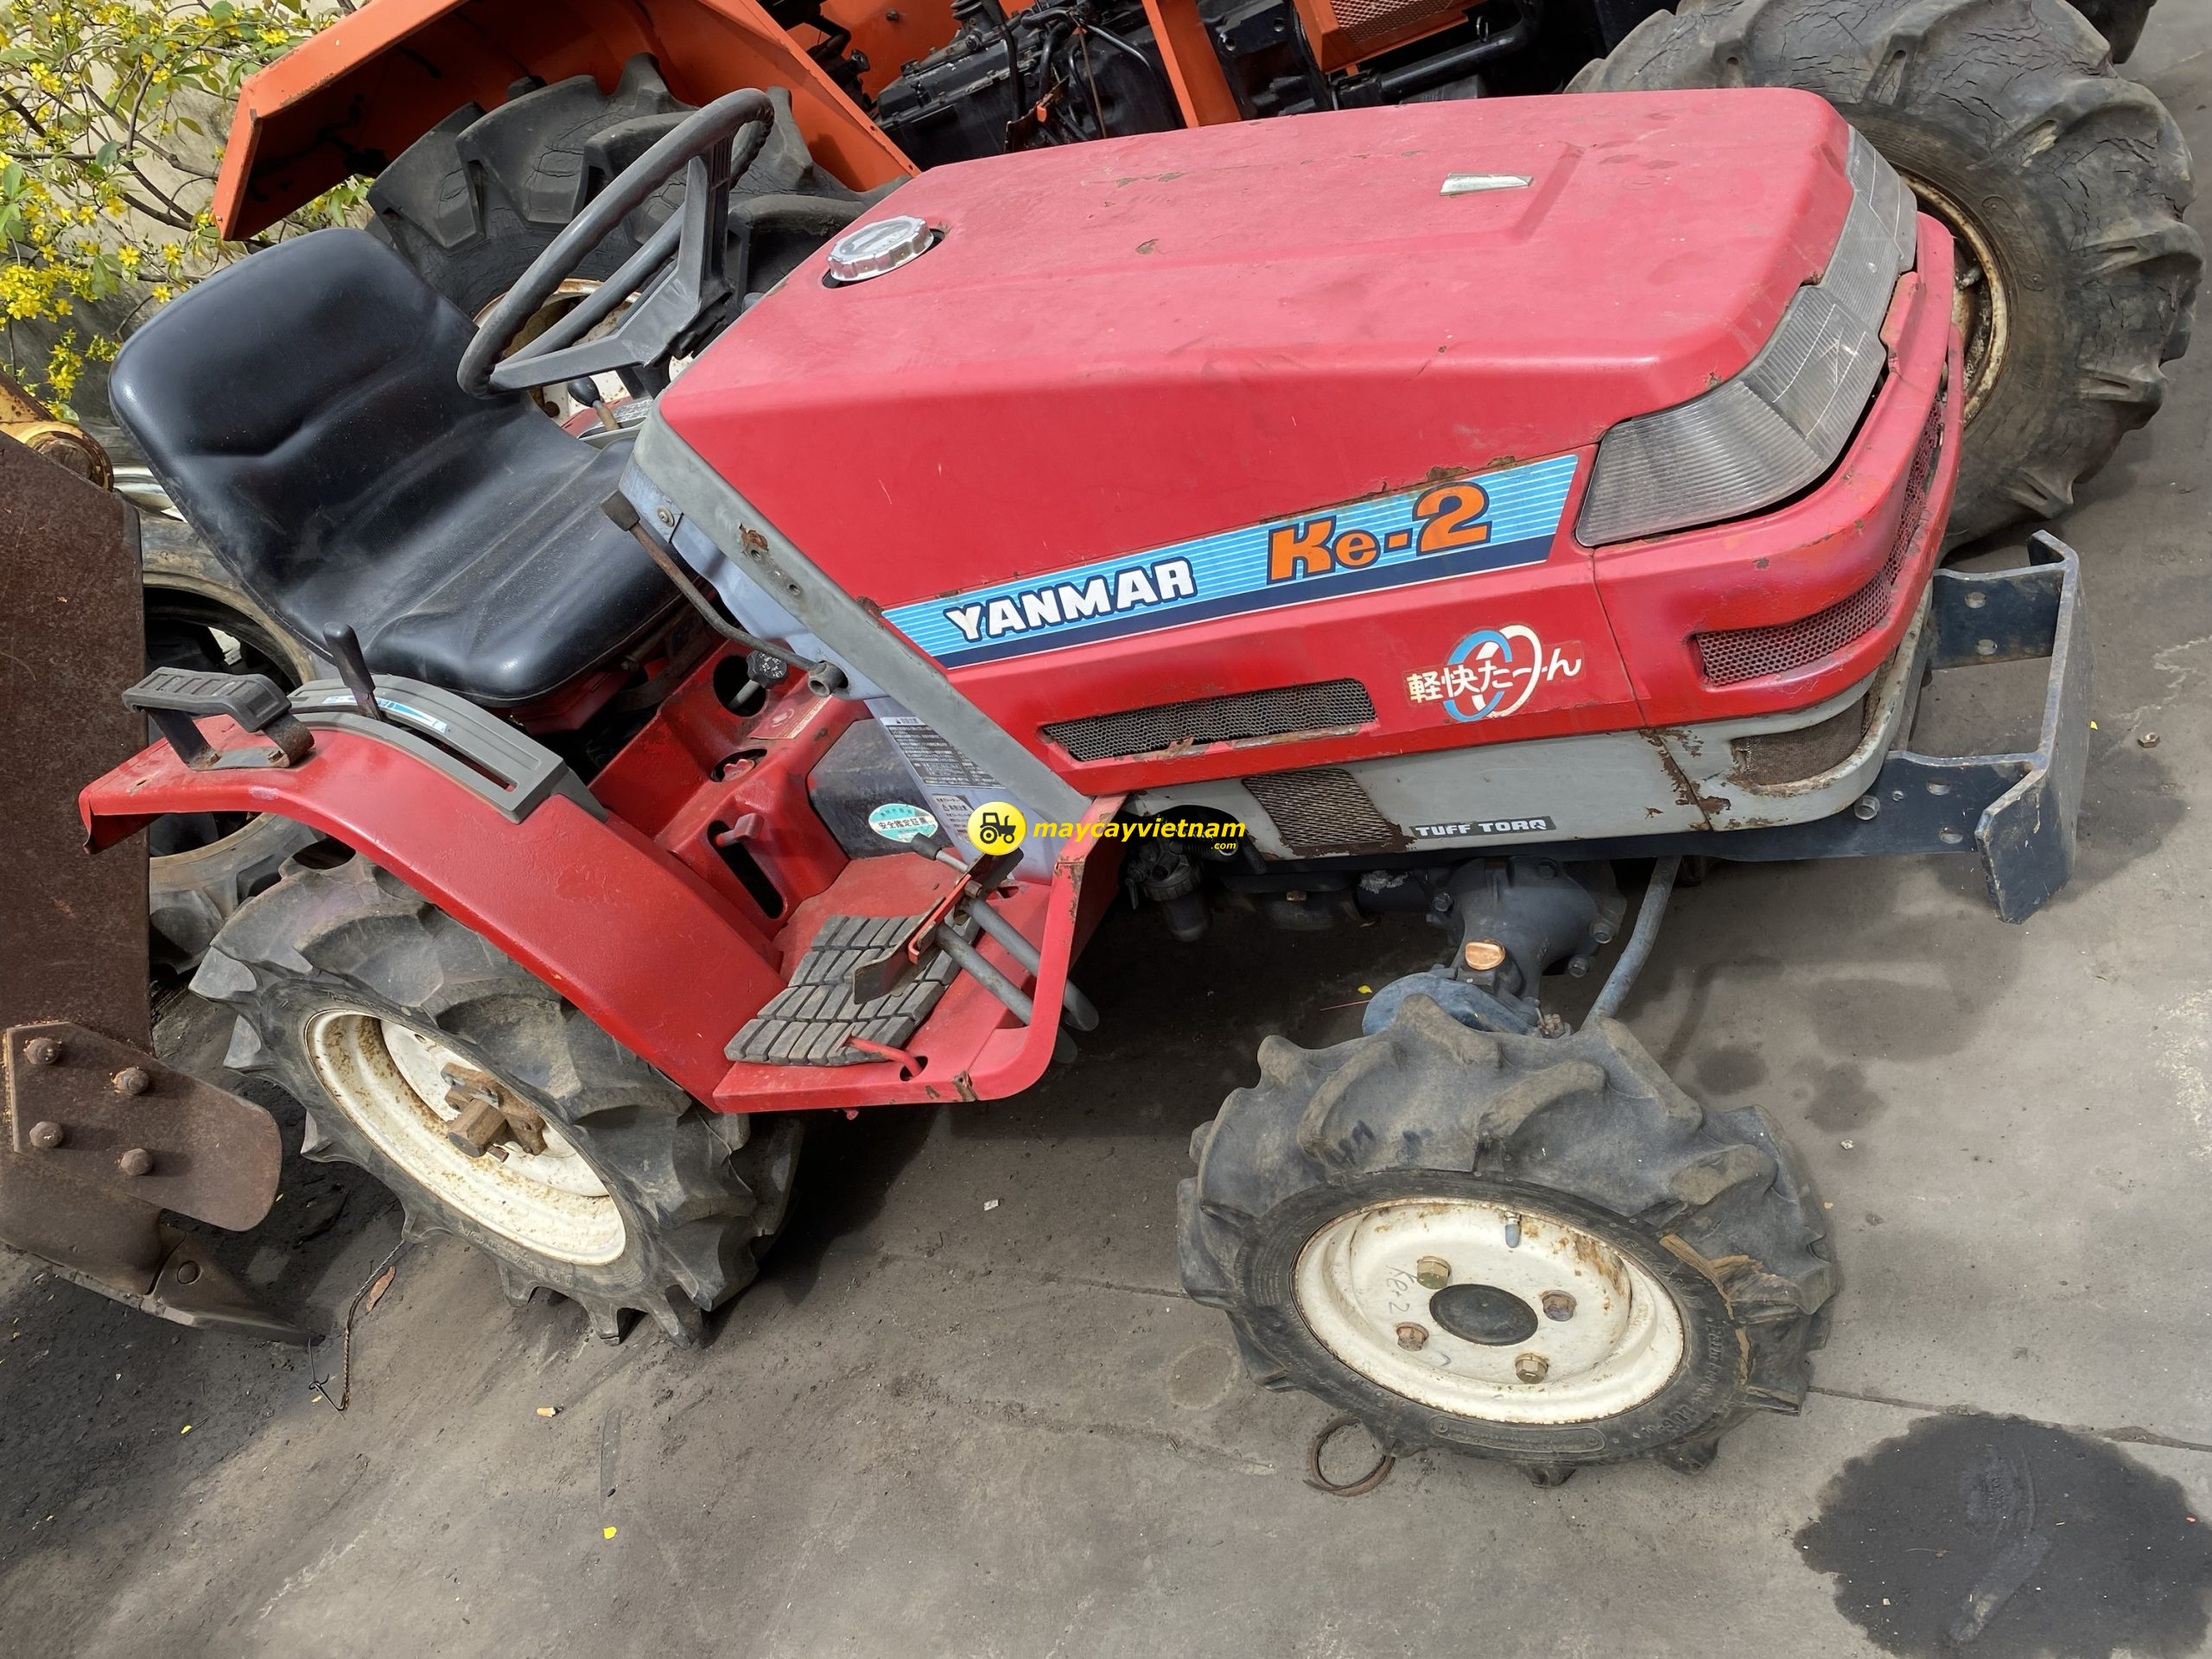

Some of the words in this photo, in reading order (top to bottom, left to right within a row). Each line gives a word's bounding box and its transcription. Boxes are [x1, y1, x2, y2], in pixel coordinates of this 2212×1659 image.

[944, 558, 1197, 641] YANMAR
[1267, 481, 1492, 585] Ke-2
[1414, 823, 1471, 836] TUFF
[1478, 819, 1548, 832] TORQ
